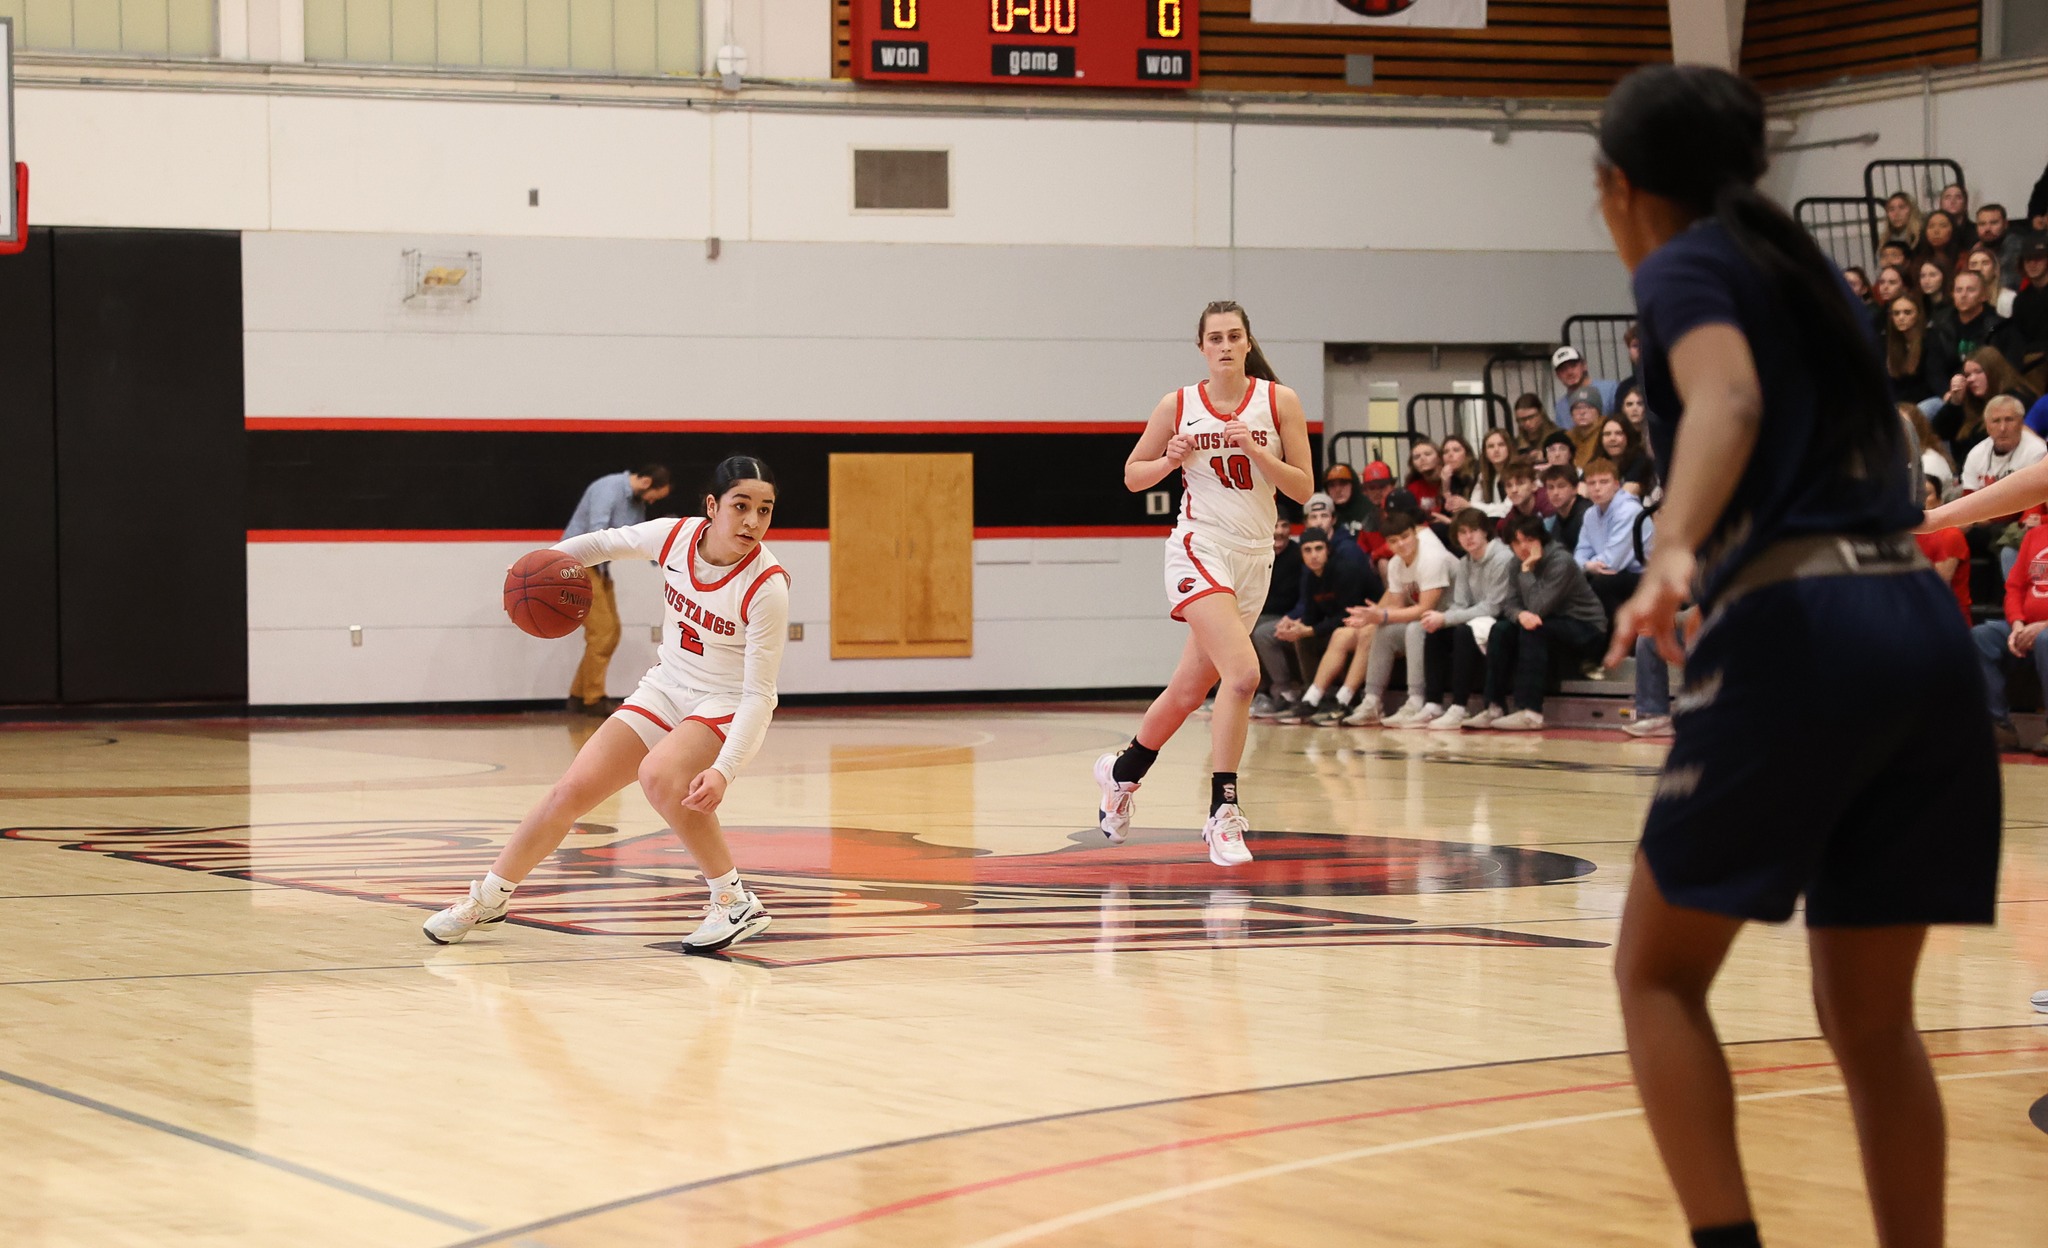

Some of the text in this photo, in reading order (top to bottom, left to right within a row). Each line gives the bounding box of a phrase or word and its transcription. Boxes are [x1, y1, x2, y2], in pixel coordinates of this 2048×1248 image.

[880, 47, 920, 67] won
[1009, 51, 1058, 75] game
[1145, 55, 1183, 75] won
[1191, 430, 1268, 451] USTGS
[1209, 454, 1254, 491] 10
[677, 620, 704, 657] 2
